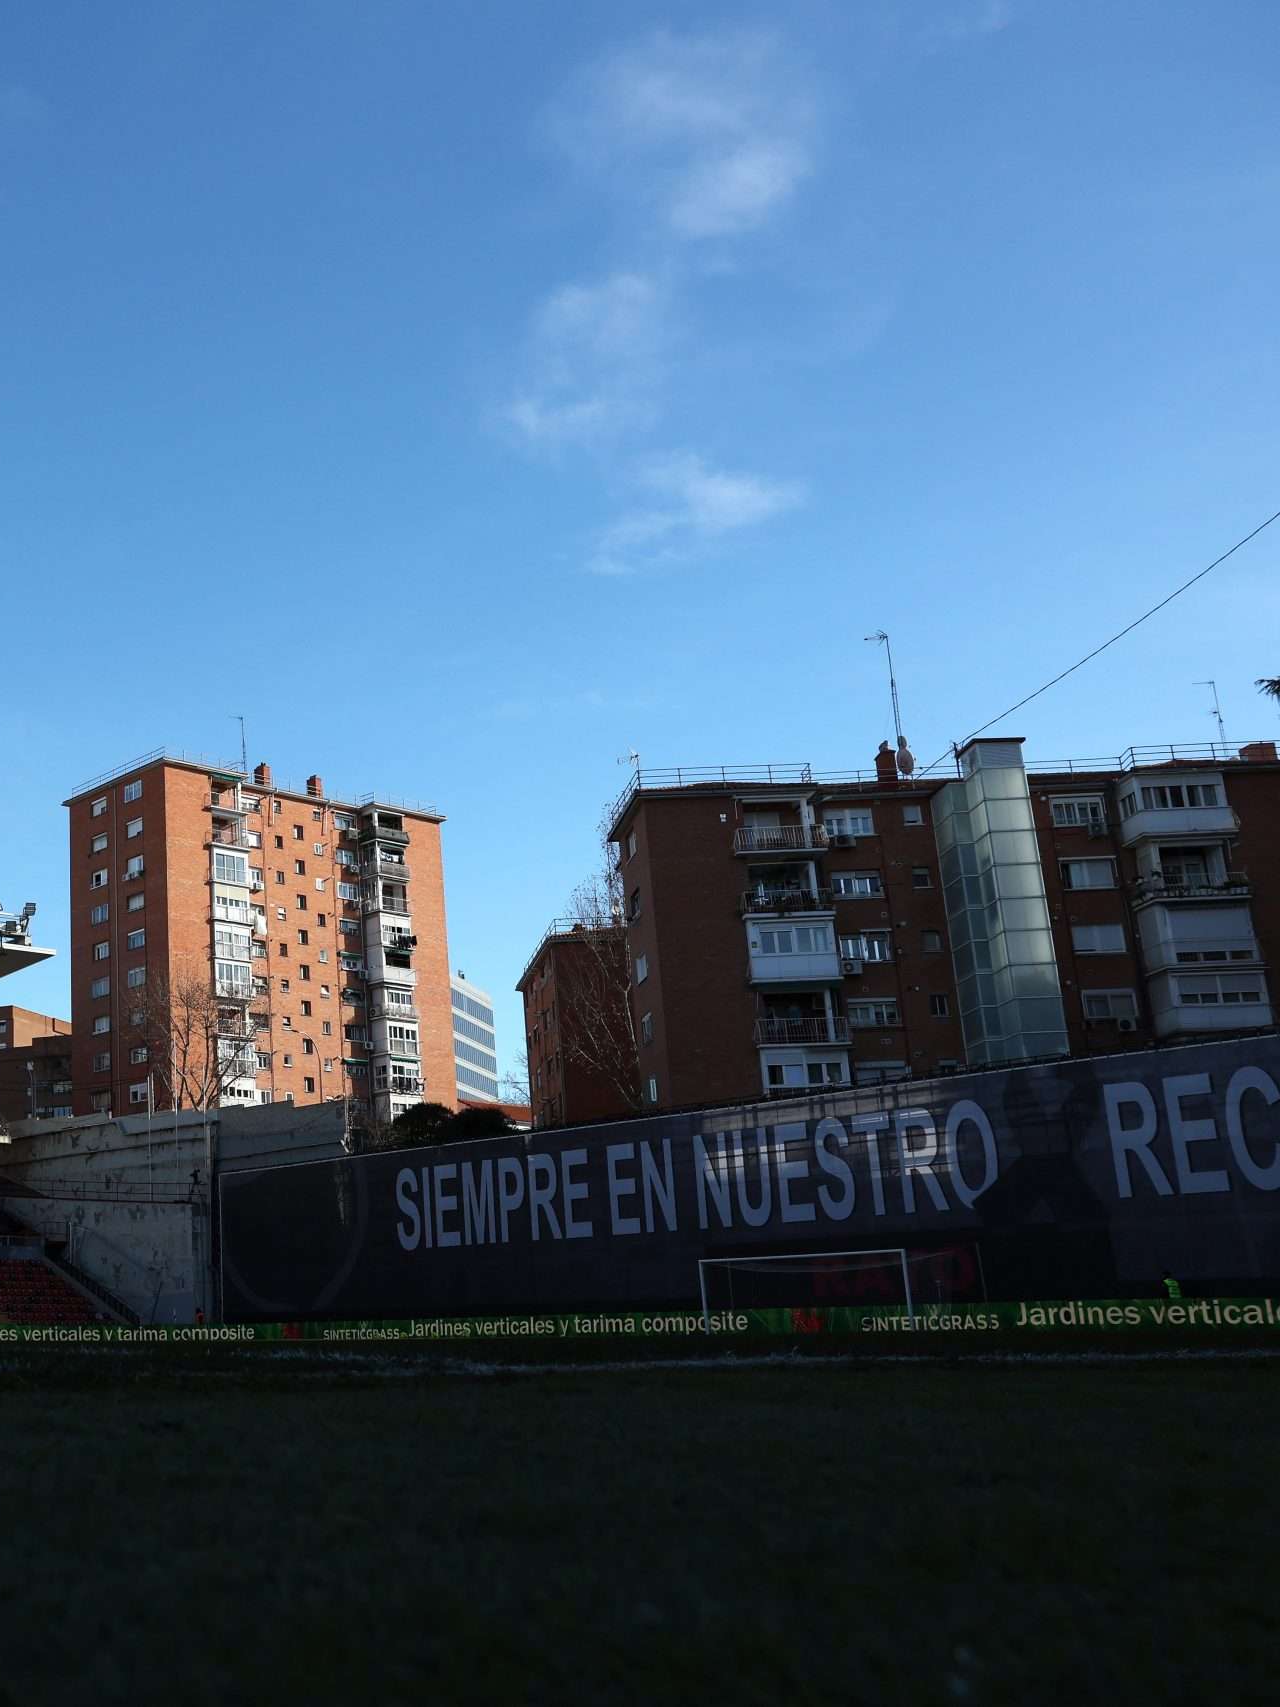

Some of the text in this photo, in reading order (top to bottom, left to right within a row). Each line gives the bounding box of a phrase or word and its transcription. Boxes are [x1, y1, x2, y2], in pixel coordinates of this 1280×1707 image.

[395, 1065, 1280, 1252] SIEMPRE EN NUESTRO REC
[408, 1318, 471, 1338] Jardines
[475, 1316, 555, 1337] verticales
[559, 1319, 569, 1338] y
[574, 1314, 635, 1334] tarima
[641, 1311, 749, 1336] composite
[861, 1297, 1280, 1332] SINTETICGRASS Jardines vertical
[22, 1325, 101, 1342] verticales
[118, 1326, 168, 1341] tarima
[172, 1325, 255, 1342] composite
